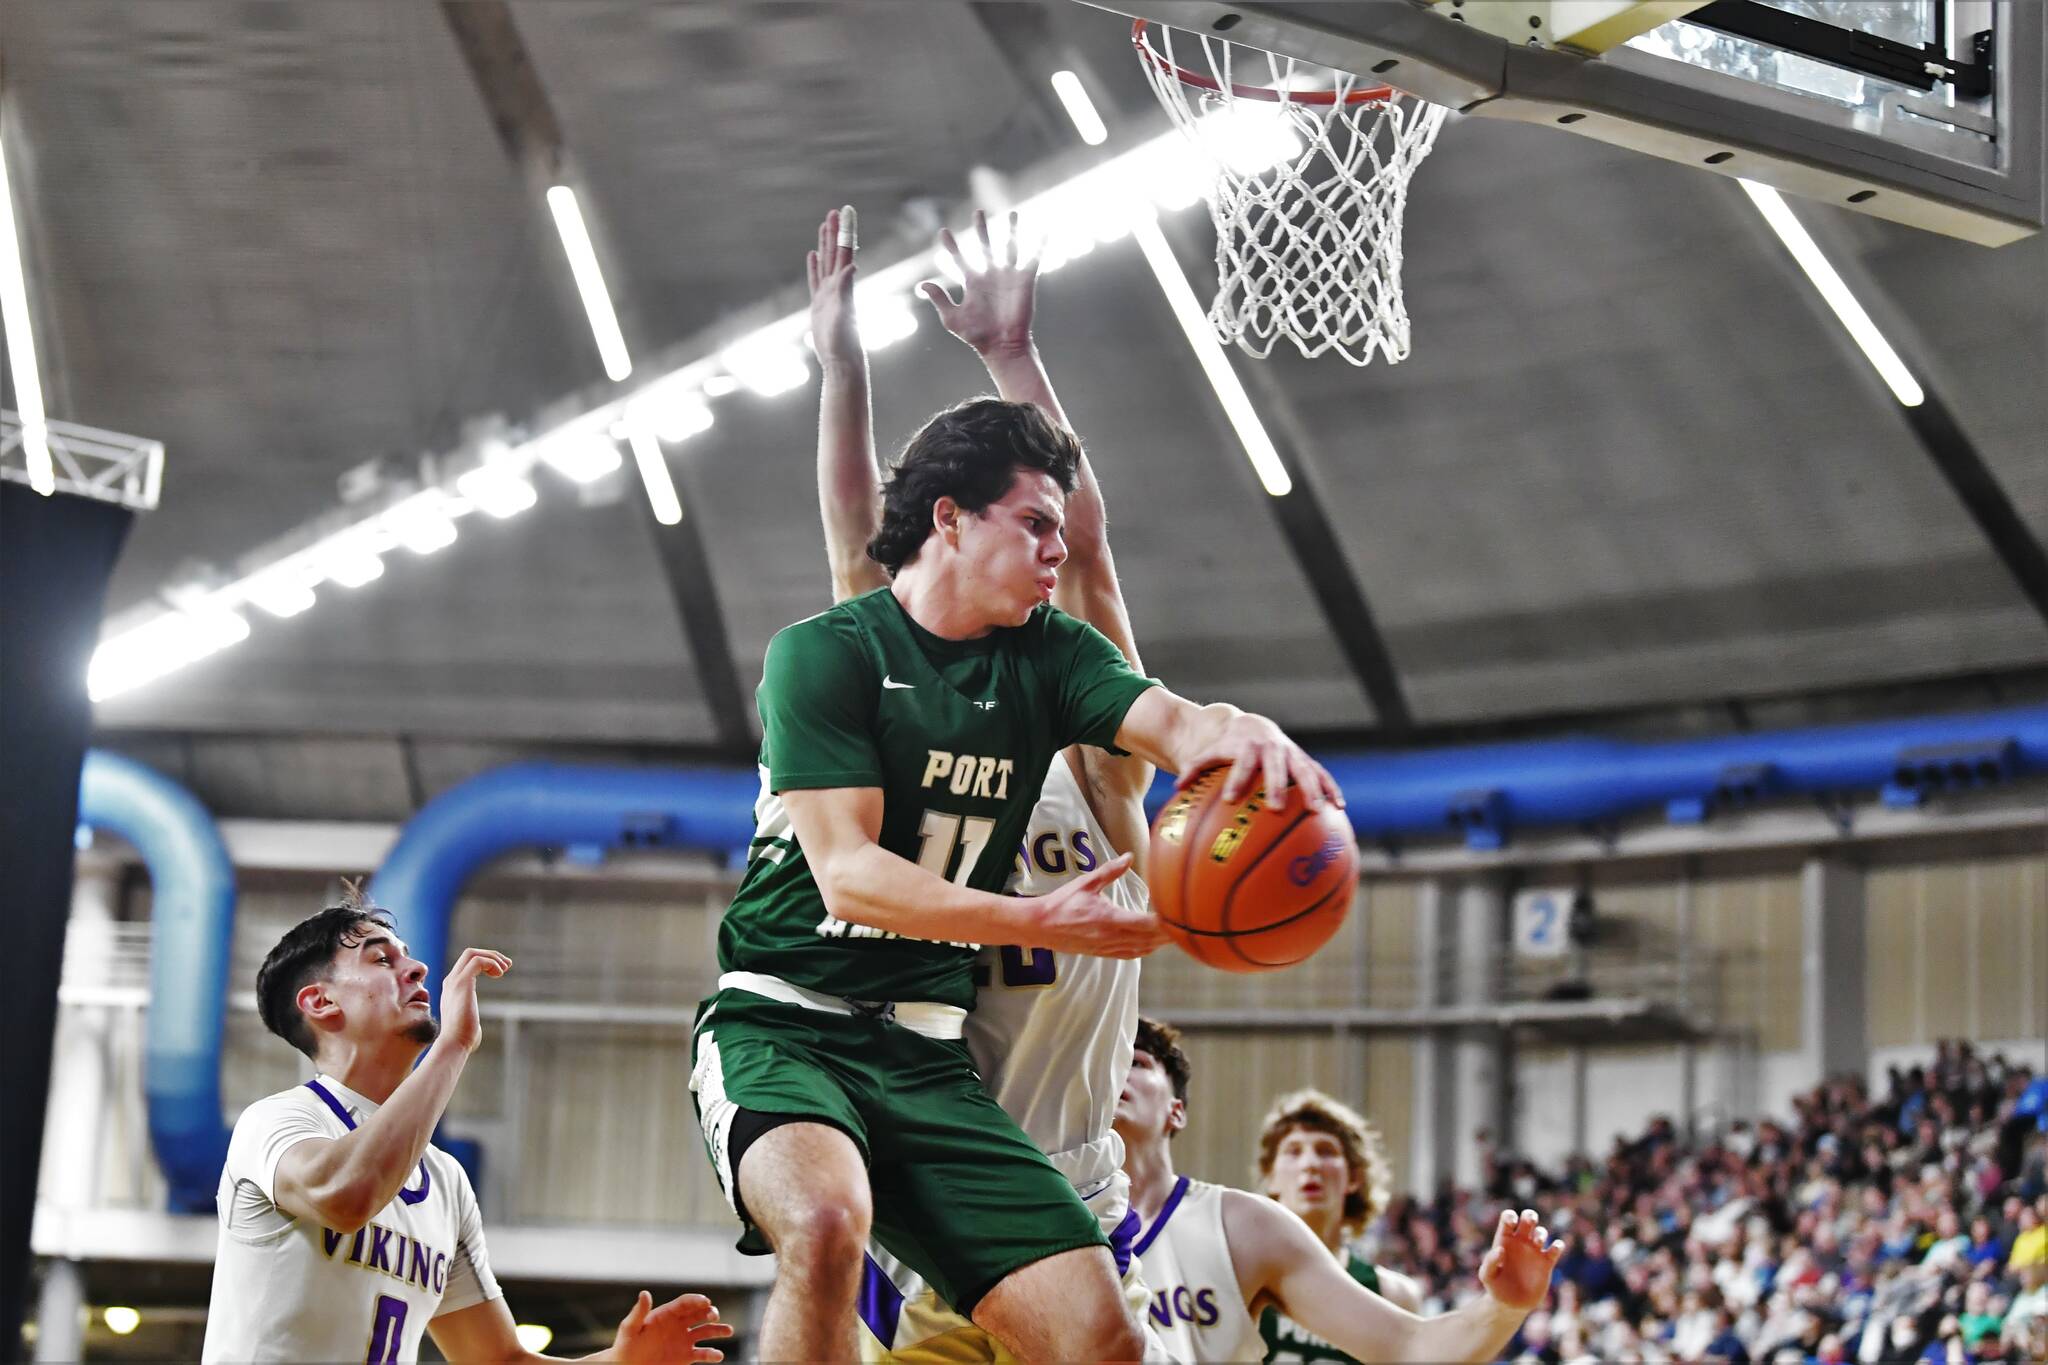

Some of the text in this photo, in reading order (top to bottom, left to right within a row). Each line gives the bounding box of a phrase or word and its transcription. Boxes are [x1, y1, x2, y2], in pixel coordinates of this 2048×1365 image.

[920, 749, 1014, 800] PORT
[1528, 895, 1559, 945] 2
[320, 1221, 454, 1297] VIKING
